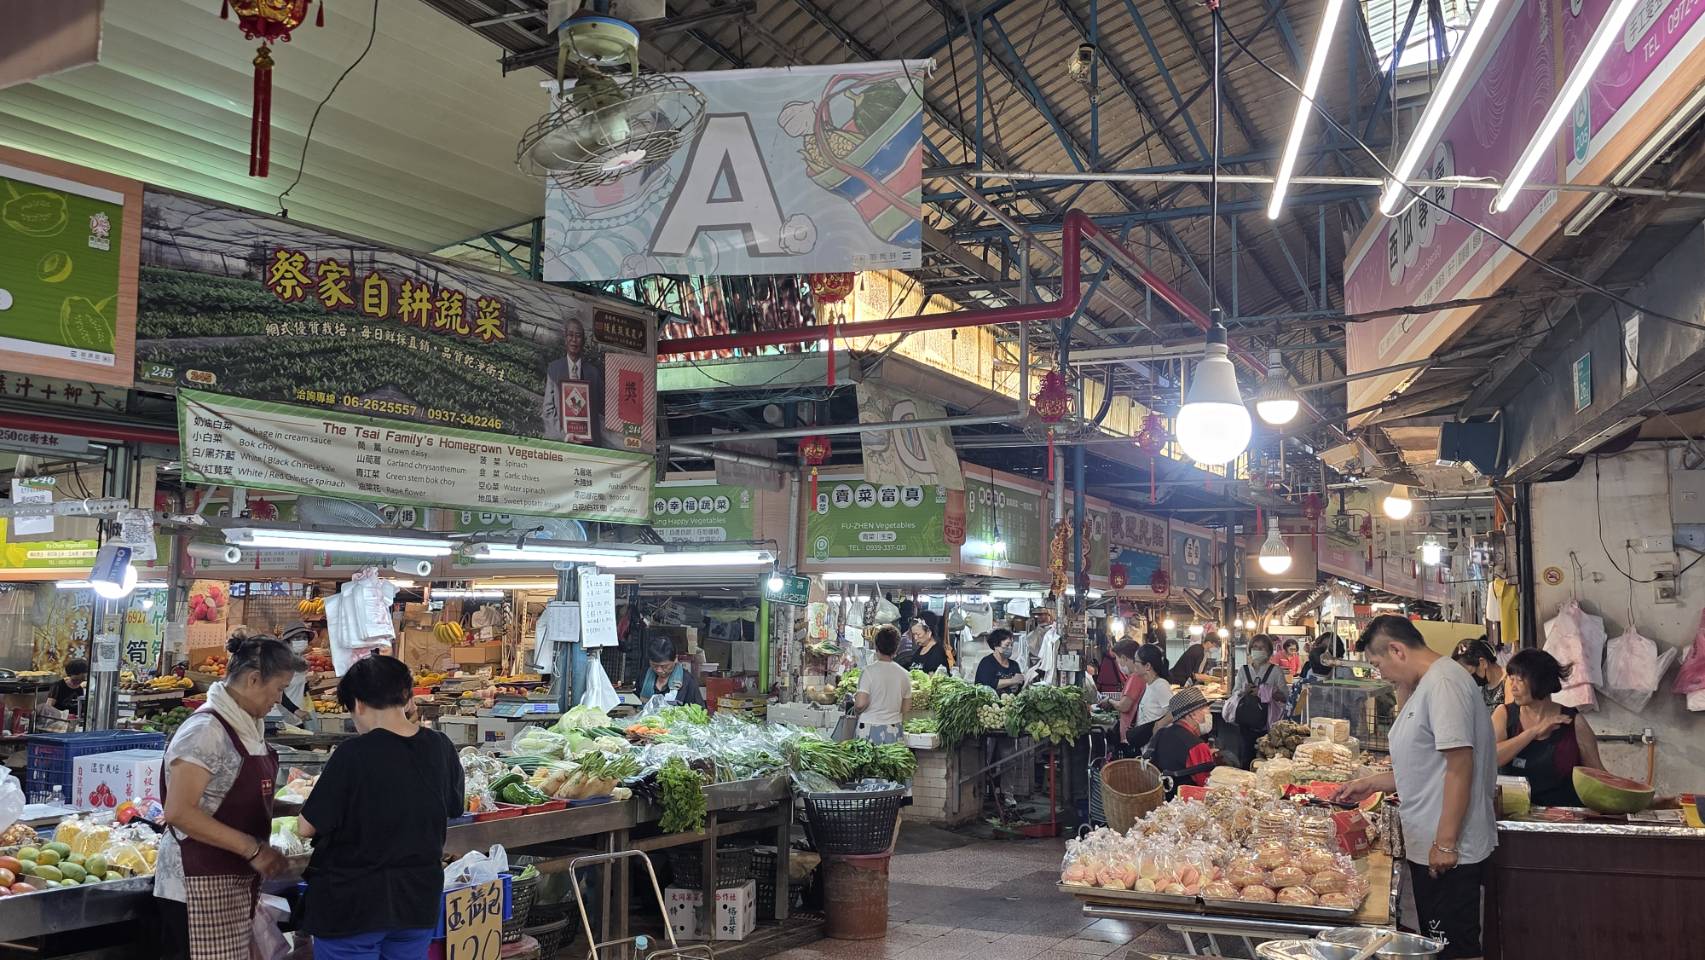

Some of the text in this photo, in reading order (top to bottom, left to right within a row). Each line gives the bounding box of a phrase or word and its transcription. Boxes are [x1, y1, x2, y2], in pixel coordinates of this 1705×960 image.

[1642, 33, 1660, 63] TEL
[646, 111, 797, 258] A
[267, 250, 506, 341] 蔡家自耕蔬菜
[151, 366, 174, 378] 245
[343, 395, 417, 416] 06-2625557
[427, 408, 502, 430] 0937-342246
[193, 416, 233, 431] 奶油白菜
[192, 432, 223, 444] 小白菜
[239, 438, 255, 448] Bok
[274, 430, 282, 439] in
[284, 434, 309, 442] cream
[310, 437, 332, 445] sauce
[322, 422, 564, 462] The Tsai Family's Homegrown Vegetables
[240, 451, 262, 461] White
[267, 456, 289, 466] Black
[504, 460, 528, 469] Spinach
[386, 459, 467, 474] Garland chrysanthemum
[238, 467, 263, 477] White
[269, 470, 284, 479] Red
[315, 478, 346, 488] spinach
[385, 472, 407, 481] Green
[504, 471, 521, 480] Garlic
[503, 483, 546, 495] Water spinach
[835, 487, 920, 503] 賣菜富真
[875, 521, 916, 530] Vegetables
[126, 640, 148, 664] 筍
